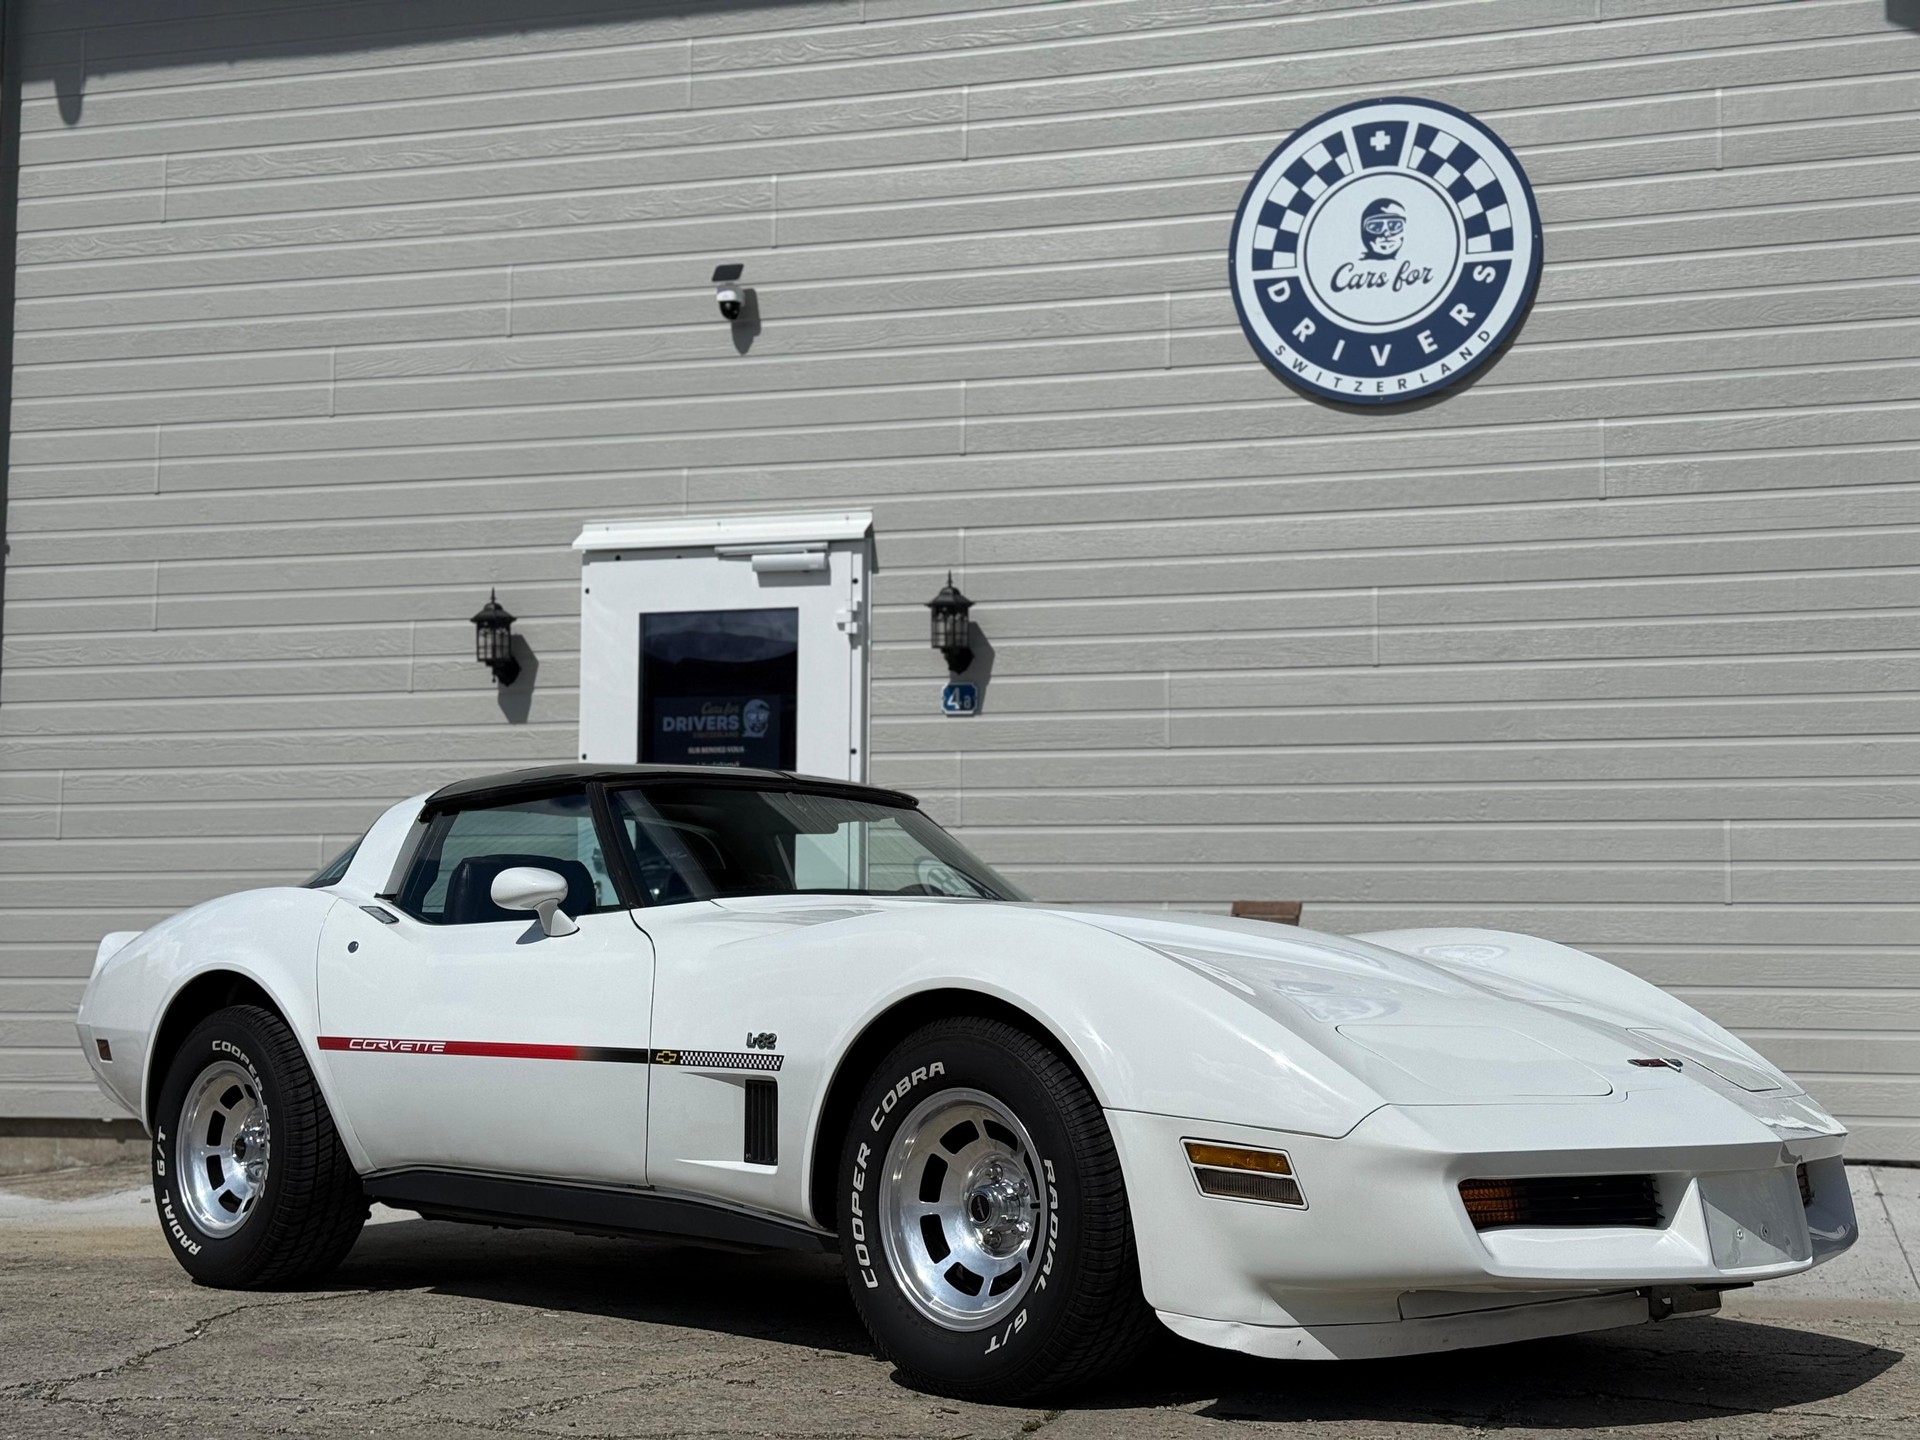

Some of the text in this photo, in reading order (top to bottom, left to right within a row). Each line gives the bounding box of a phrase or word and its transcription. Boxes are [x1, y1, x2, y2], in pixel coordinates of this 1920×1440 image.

[1330, 260, 1434, 293] Cars for
[1267, 264, 1497, 367] DRIVERS
[1274, 329, 1491, 393] SWITZERLAND
[662, 715, 740, 732] DRIVERS
[212, 1040, 264, 1093] COOPER
[349, 1039, 446, 1052] CORVETTE
[157, 1126, 202, 1256] RADIAL G/T
[852, 1061, 945, 1289] COOPER COBRA
[984, 1158, 1059, 1355] RADIAL G/T
